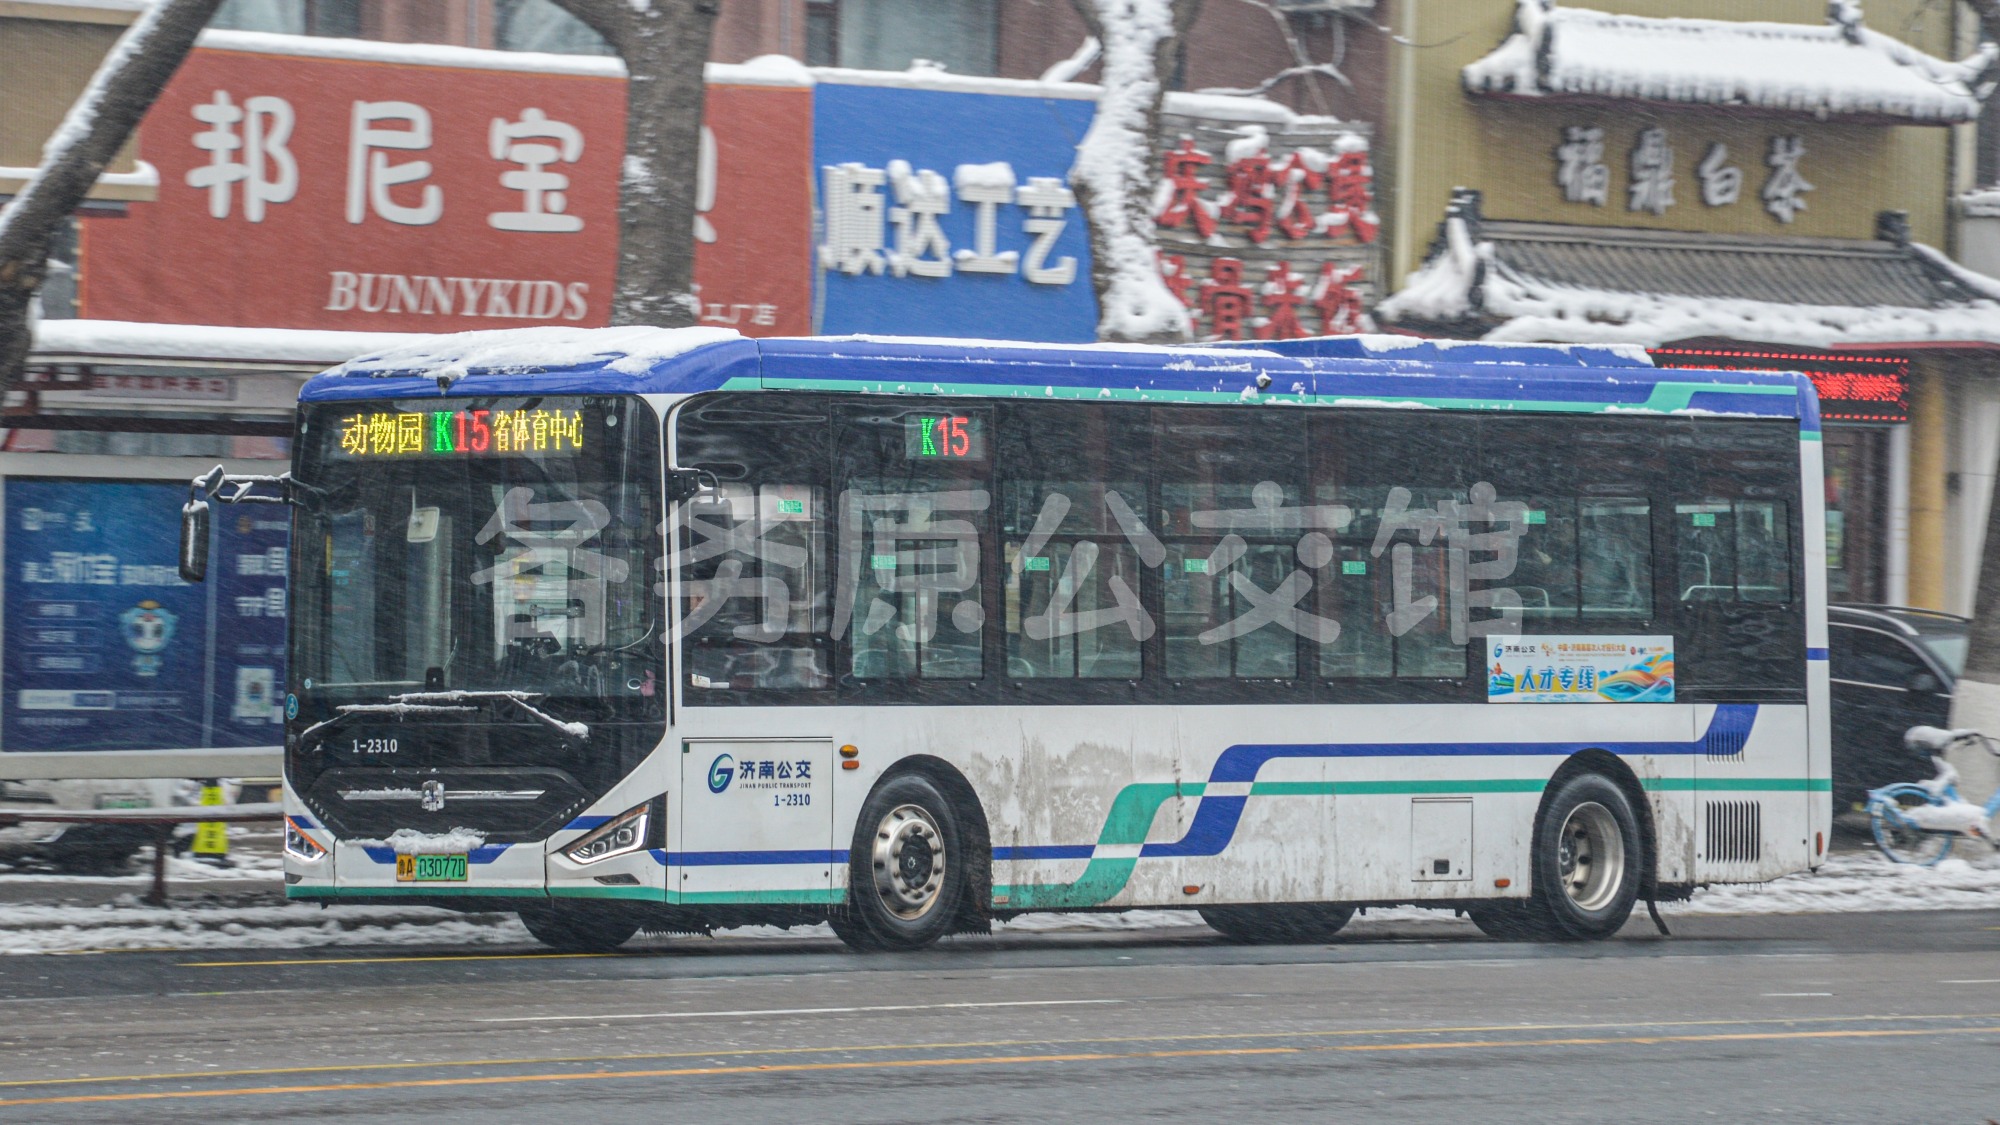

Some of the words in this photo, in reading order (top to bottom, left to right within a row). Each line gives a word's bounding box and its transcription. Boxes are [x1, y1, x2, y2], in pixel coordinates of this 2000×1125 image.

[186, 90, 718, 243] 邦尼宝
[1558, 127, 1815, 223] 福鼎白茶
[817, 159, 1078, 284] 顺达工艺
[324, 270, 589, 320] BUNNYKIDS
[341, 413, 423, 455] 动物园
[434, 410, 490, 452] K15
[494, 409, 583, 452] 省体育中心
[921, 417, 969, 456] K15
[1520, 666, 1594, 692] 人才专线
[353, 739, 398, 753] 1-2310
[740, 760, 811, 780] 济南公交
[774, 794, 811, 807] 1-2310
